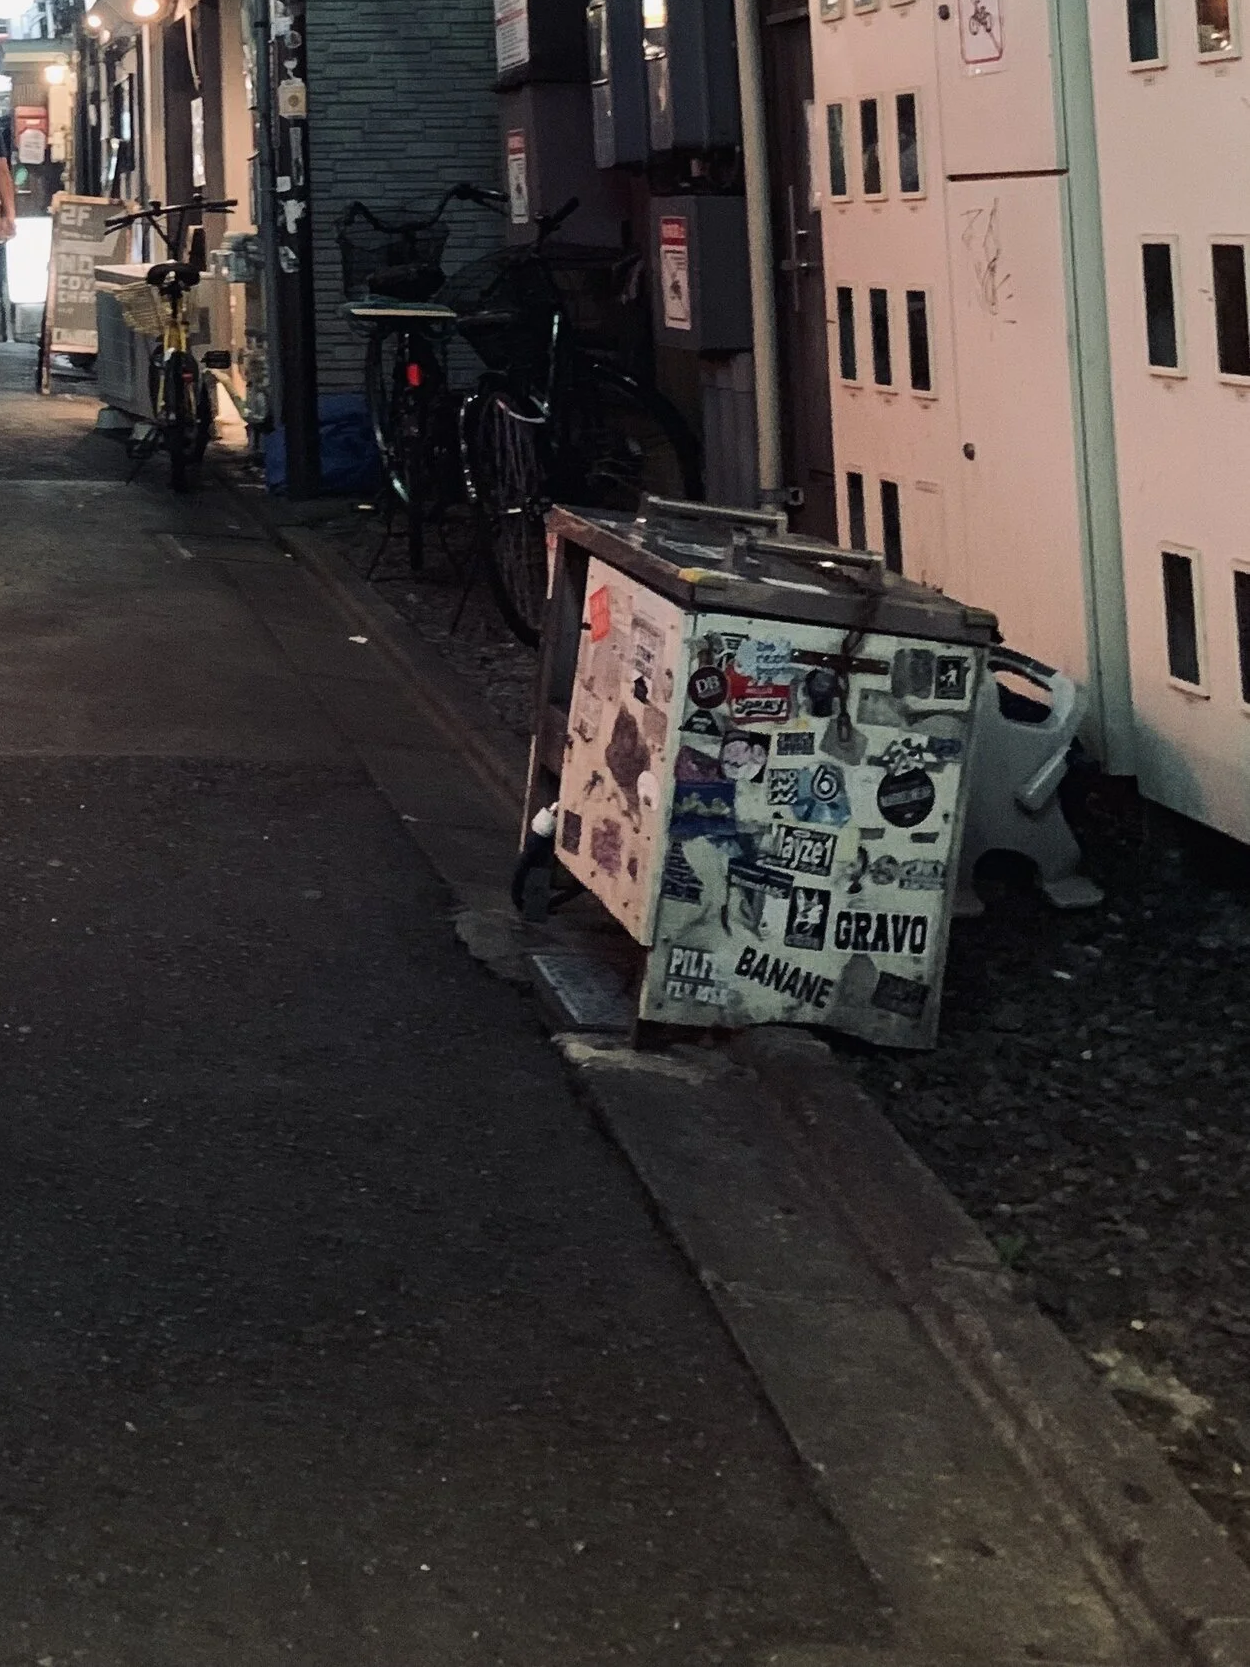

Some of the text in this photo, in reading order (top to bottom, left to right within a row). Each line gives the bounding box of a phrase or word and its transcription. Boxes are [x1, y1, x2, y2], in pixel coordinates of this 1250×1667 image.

[60, 205, 92, 227] 2F
[835, 911, 925, 954] GRAVO
[734, 945, 834, 1010] BANANE
